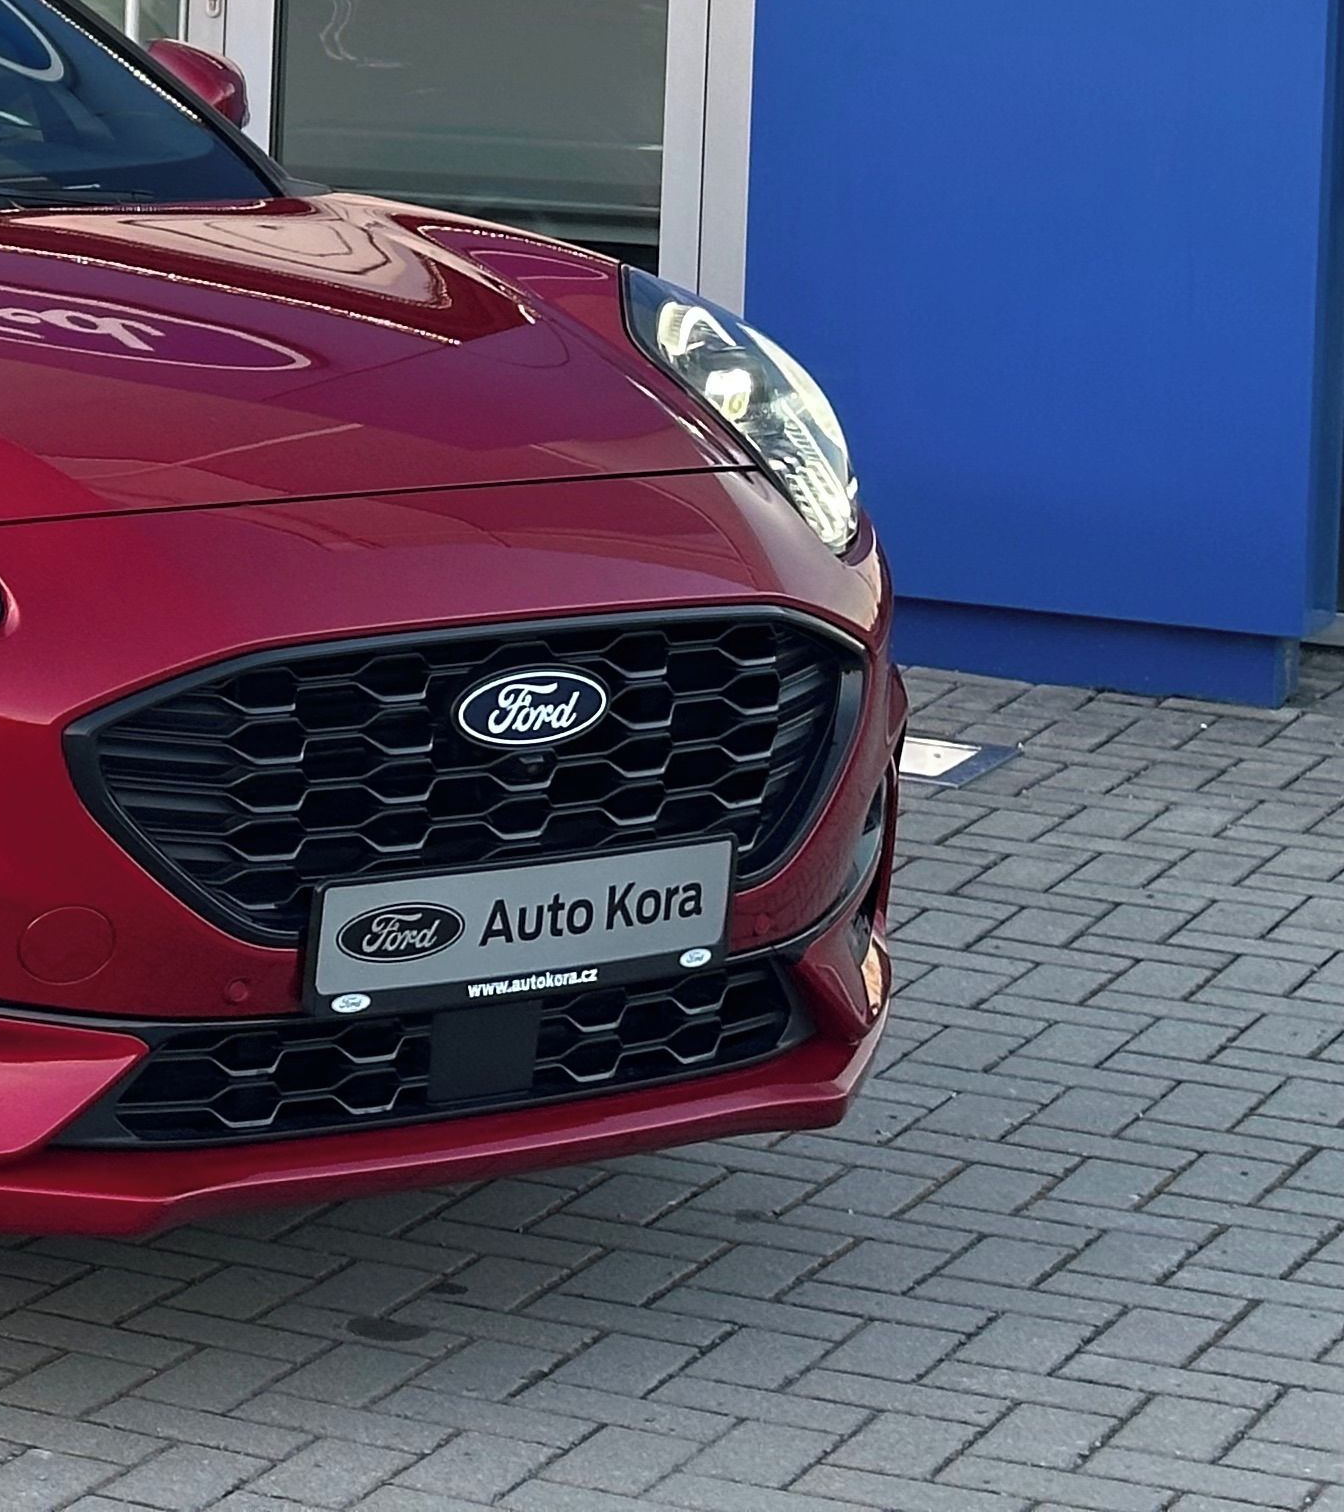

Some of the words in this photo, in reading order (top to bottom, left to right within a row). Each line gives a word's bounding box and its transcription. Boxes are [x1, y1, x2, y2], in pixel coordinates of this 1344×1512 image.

[487, 681, 581, 734] Ford
[361, 912, 438, 954] Ford
[478, 893, 595, 948] Auto
[605, 881, 703, 931] Kora
[467, 967, 599, 999] www.autokora.cz
